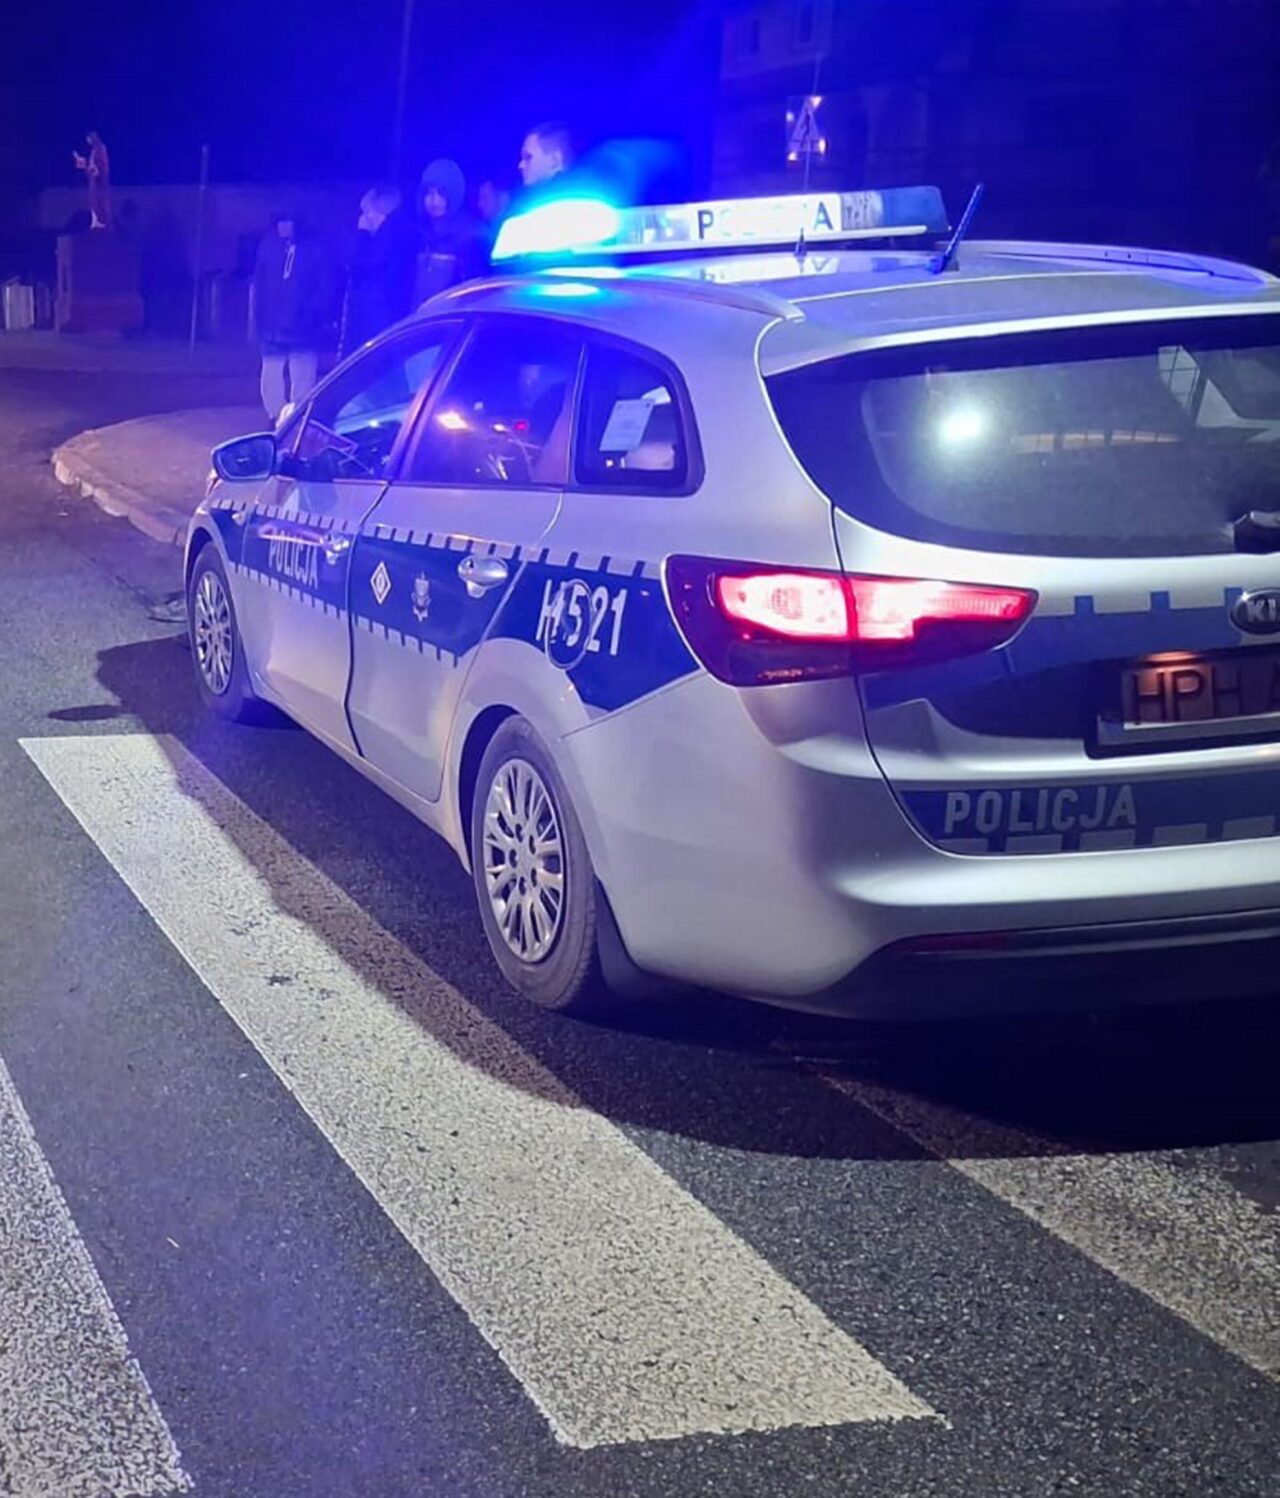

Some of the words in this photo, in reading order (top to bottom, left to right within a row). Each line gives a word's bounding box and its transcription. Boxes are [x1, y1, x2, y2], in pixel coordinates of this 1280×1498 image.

[268, 528, 319, 590] POLICJA
[1246, 598, 1280, 623] KI
[944, 784, 1137, 834] POLICJA
